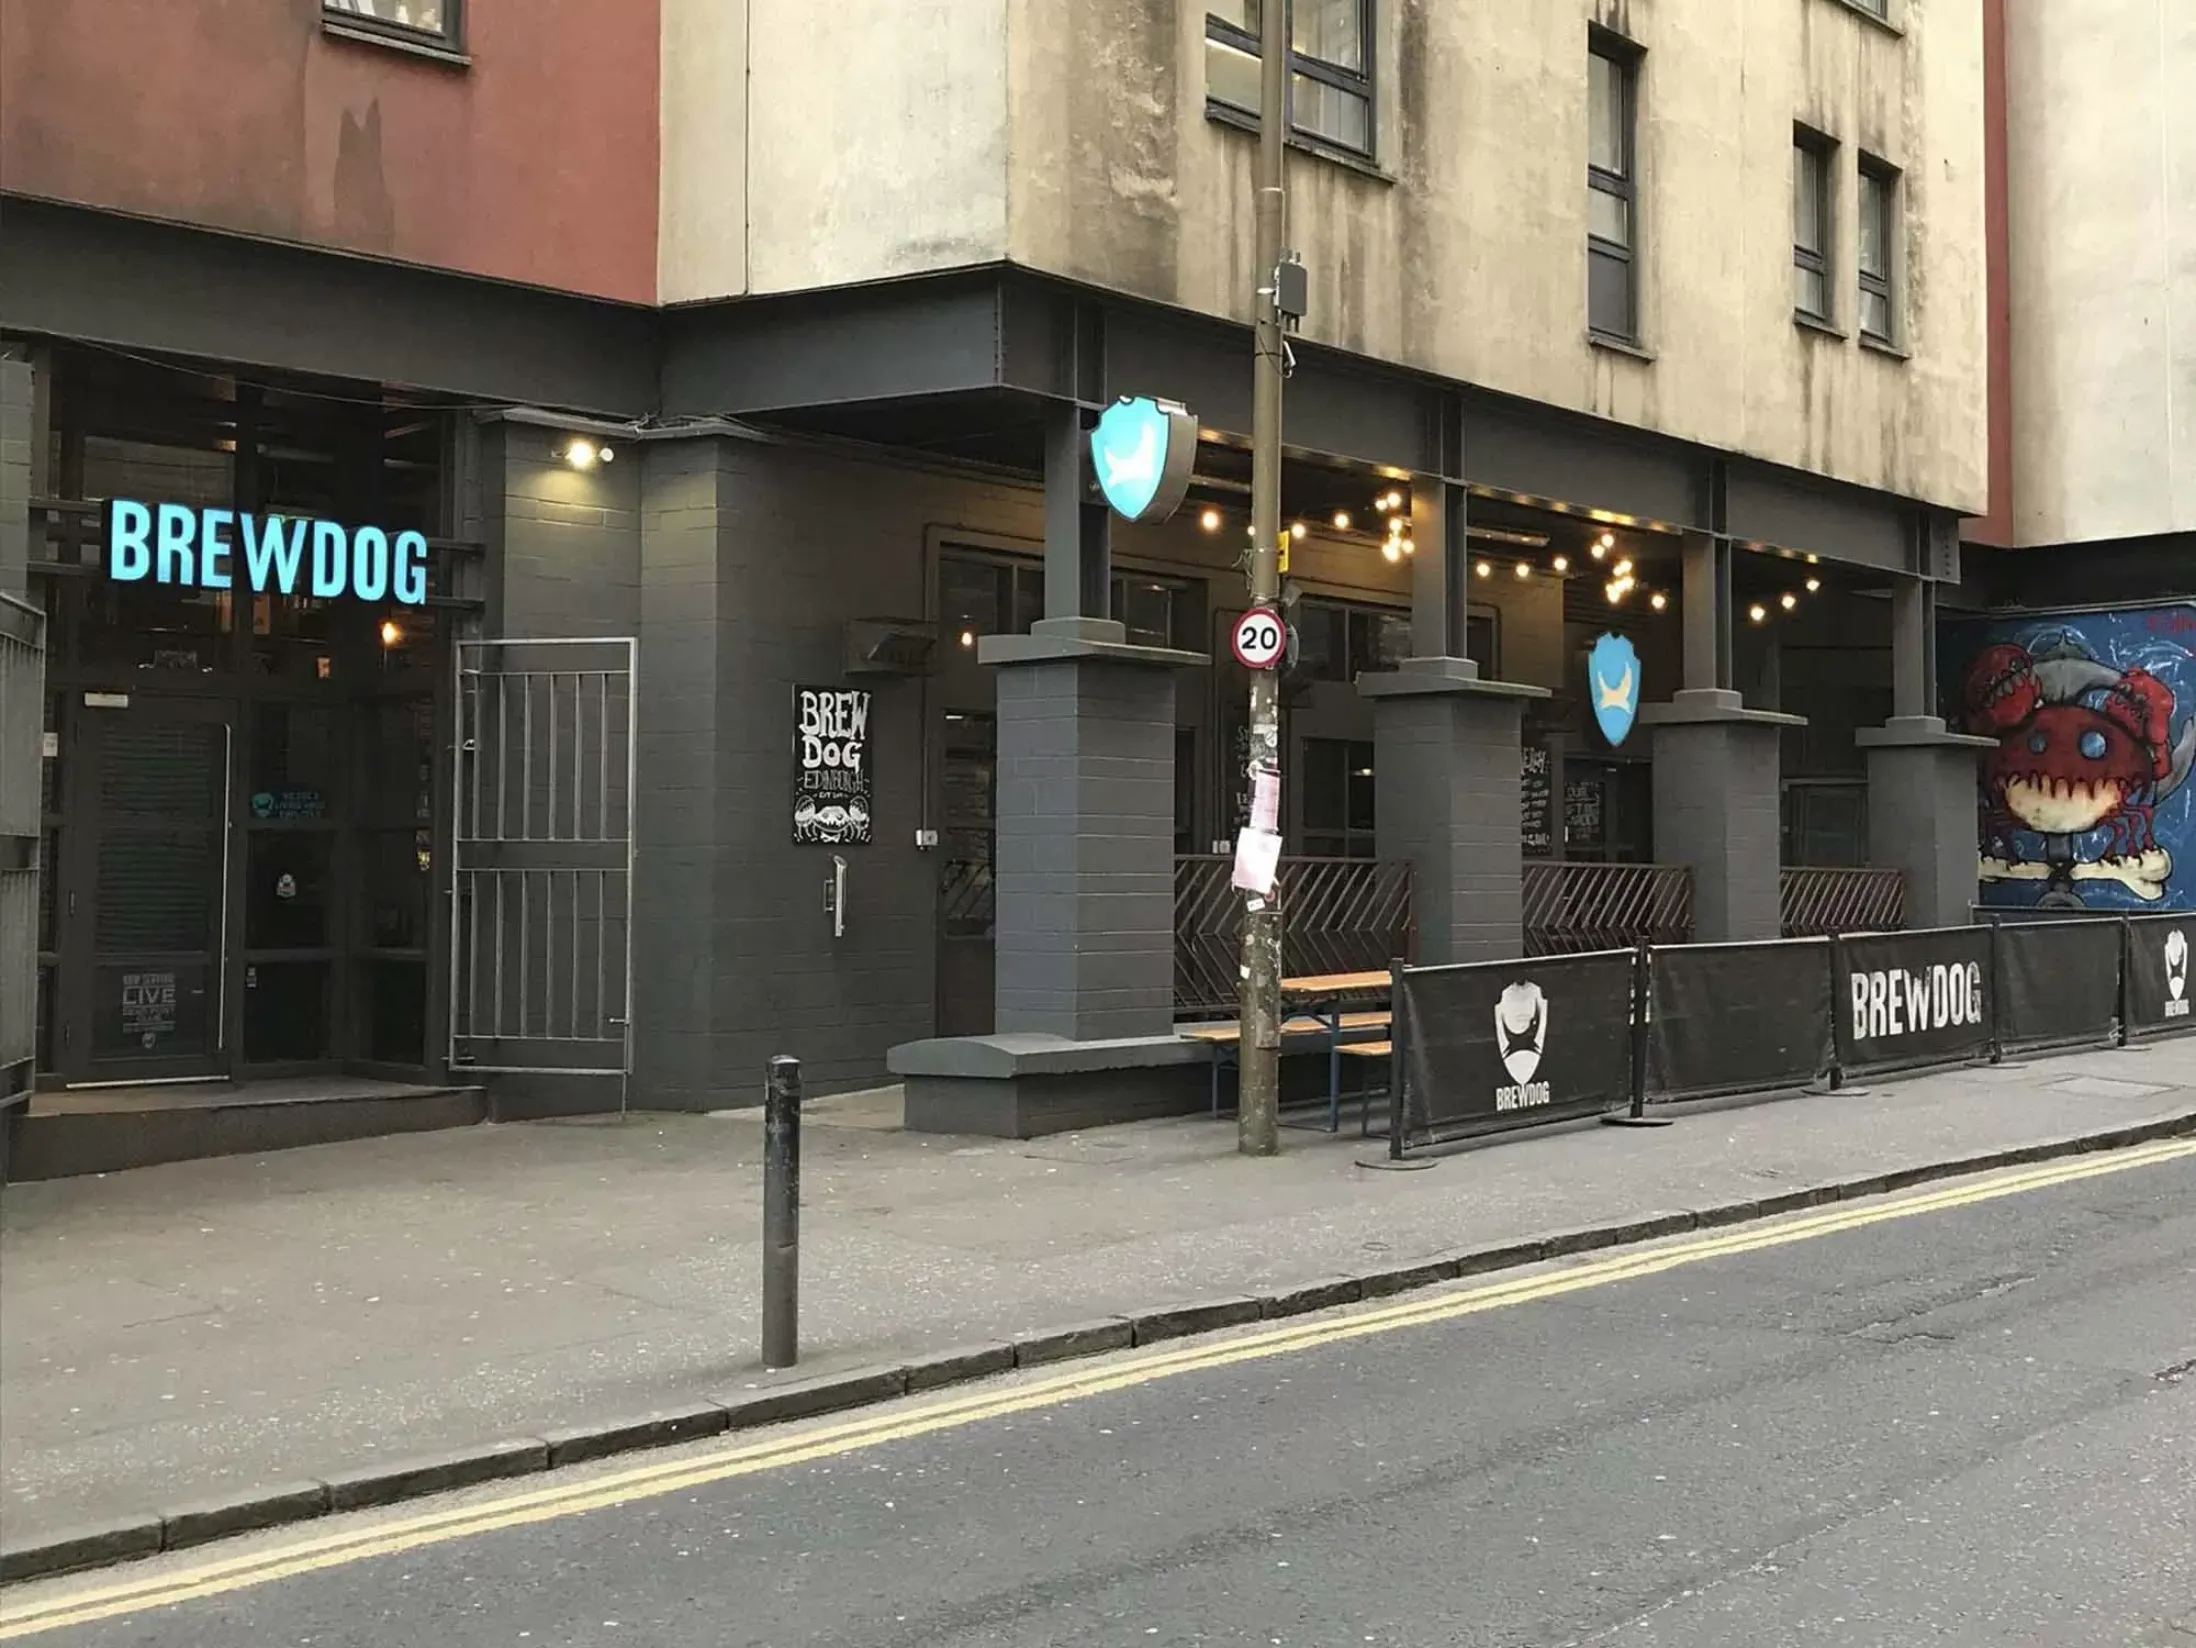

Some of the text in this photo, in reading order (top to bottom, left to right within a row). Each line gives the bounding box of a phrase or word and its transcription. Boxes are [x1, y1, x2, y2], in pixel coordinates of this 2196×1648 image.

[111, 499, 427, 606] BREWDOG
[1241, 627, 1278, 650] 20
[799, 691, 871, 740] BREW
[802, 735, 862, 773] DOG
[123, 987, 176, 1005] LIVE
[1851, 961, 1981, 1040] BREWDOG
[1496, 1081, 1550, 1112] BREWDOG
